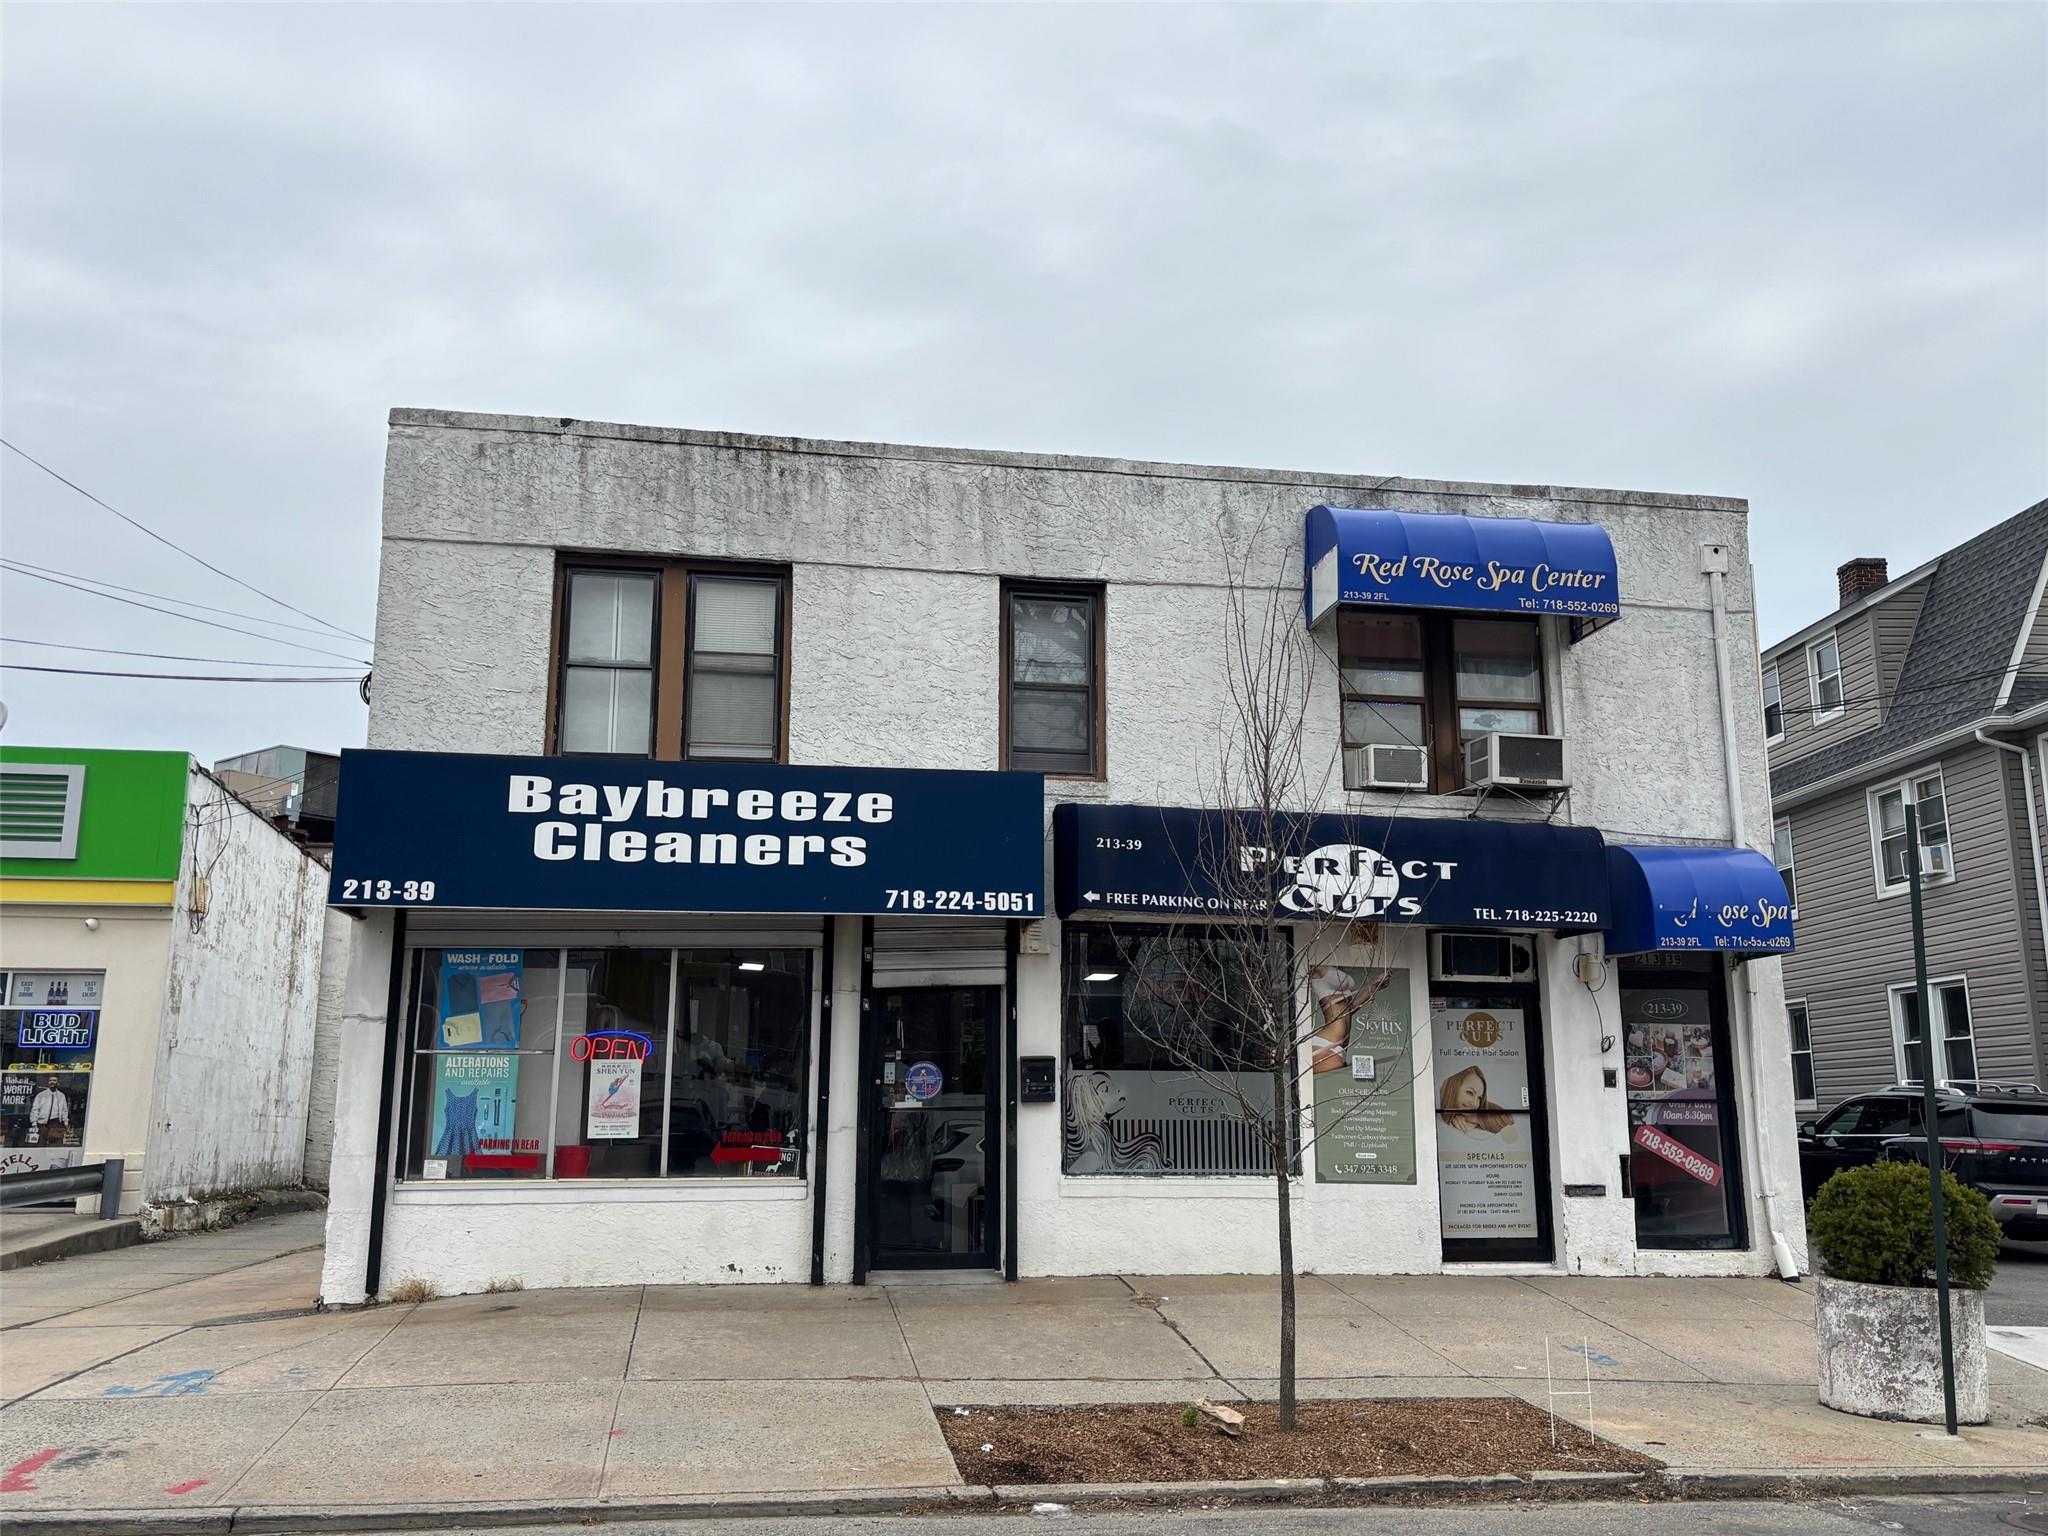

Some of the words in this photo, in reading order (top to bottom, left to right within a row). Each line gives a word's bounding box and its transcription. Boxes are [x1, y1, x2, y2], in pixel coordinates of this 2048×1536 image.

[1353, 553, 1408, 584] Red
[1412, 556, 1474, 588] Rose
[1477, 560, 1526, 591] Spa
[1531, 563, 1606, 592] Center
[1343, 590, 1372, 600] 213-39
[1373, 592, 1390, 601] 2FL
[1518, 597, 1539, 609] Tel:
[1543, 599, 1618, 613] 718-552-0269
[508, 775, 893, 823] Baybreeze
[533, 821, 867, 867] Cleaners
[1096, 837, 1142, 850] 213-39
[342, 879, 435, 901] 213-39
[885, 889, 1034, 912] 718-224-5051
[1106, 892, 1139, 905] FREE
[1142, 893, 1204, 908] PARKING
[1206, 897, 1230, 909] ON
[1278, 883, 1422, 917] CUTS
[1473, 908, 1502, 920] TEL.
[1505, 909, 1598, 924] 718-225-2220
[1752, 897, 1788, 928] Spa
[1661, 937, 1686, 946] 213-39
[1687, 938, 1702, 947] 2FL
[1714, 936, 1731, 947] Tel:
[447, 953, 480, 963] WASH
[489, 953, 519, 963] FOLD
[1647, 1003, 1682, 1013] 213-39
[33, 1012, 81, 1029] BUD
[1446, 1020, 1516, 1031] PERFECT
[1460, 1031, 1504, 1041] CUTS
[570, 1036, 648, 1064] OPEN
[1440, 1048, 1452, 1056] Full
[1453, 1048, 1480, 1056] Service
[1482, 1048, 1497, 1056] Hair
[1498, 1048, 1519, 1056] Salon
[445, 1056, 510, 1068] ALTERATIONS
[445, 1068, 465, 1078] AND
[468, 1068, 509, 1078] REPAIRS
[3, 1085, 33, 1094] WORTH
[2, 1095, 25, 1104] MORE
[1182, 1106, 1214, 1114] CUTS
[478, 1138, 510, 1151] PARKING
[521, 1139, 540, 1151] REAR
[1343, 1165, 1359, 1173] 347
[1360, 1165, 1376, 1174] 925
[1377, 1165, 1398, 1174] 3348
